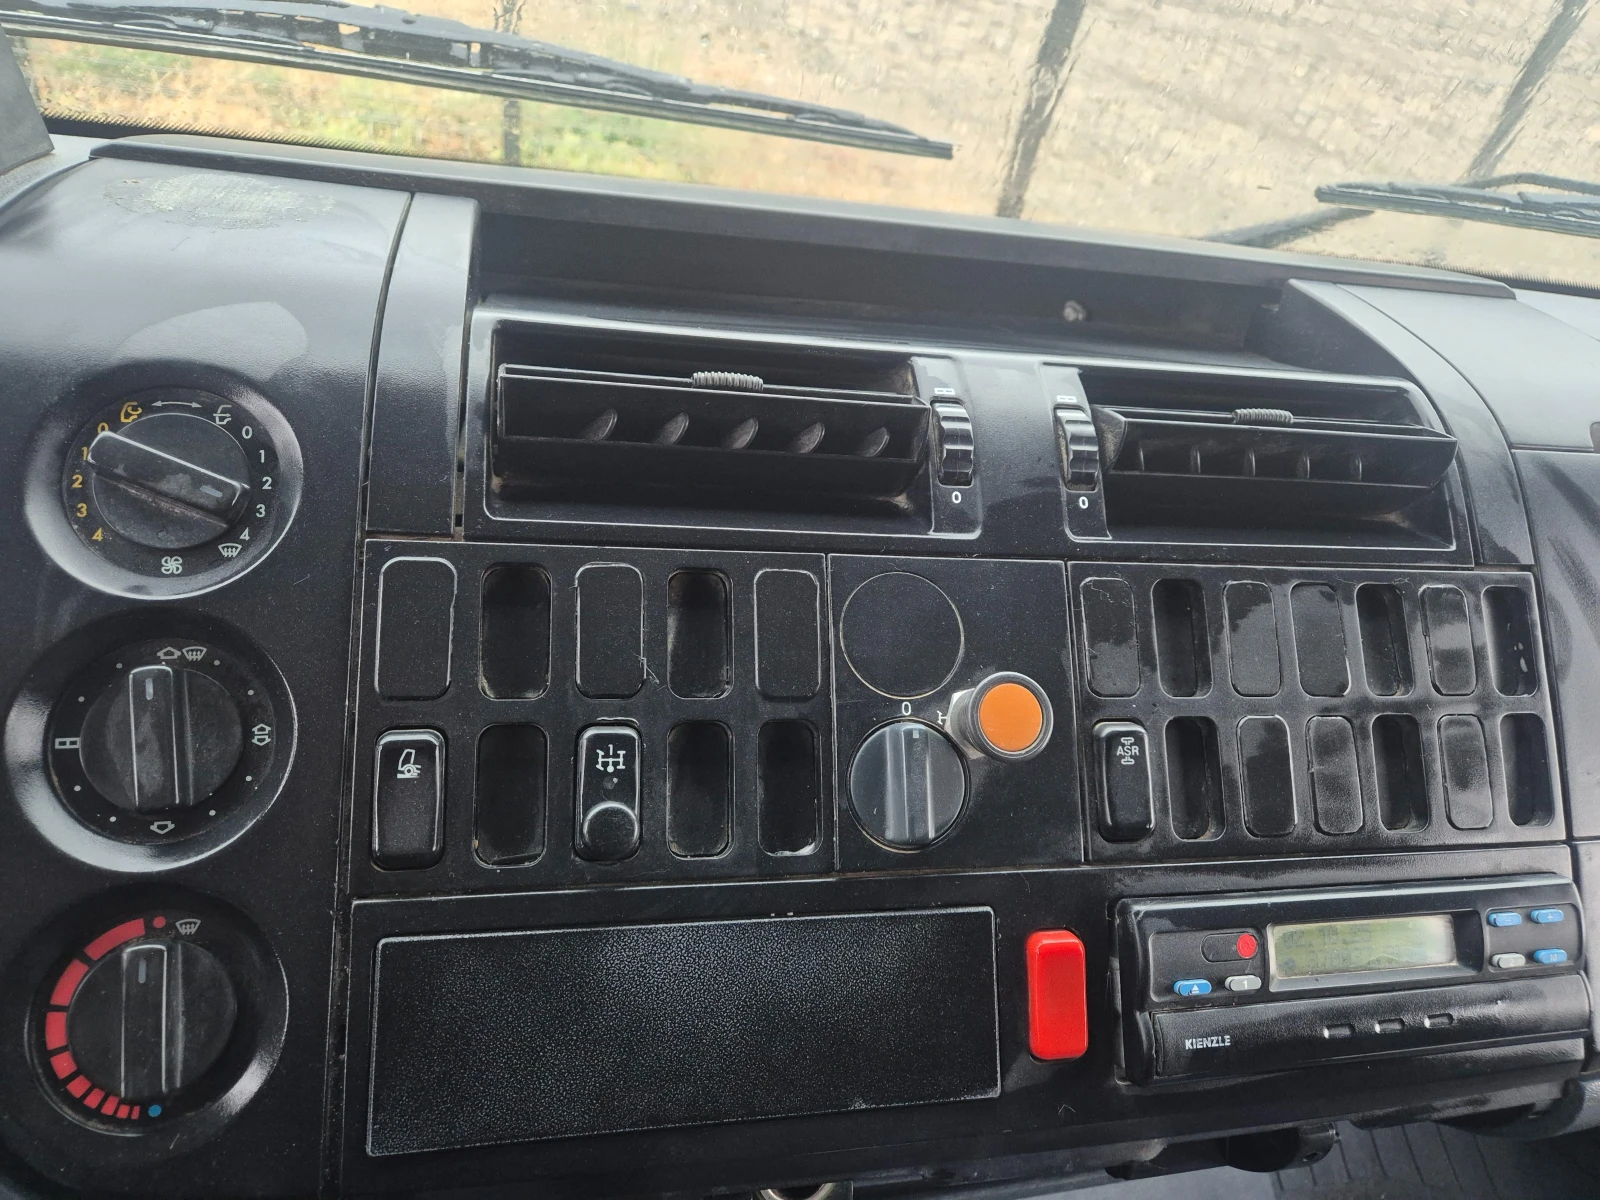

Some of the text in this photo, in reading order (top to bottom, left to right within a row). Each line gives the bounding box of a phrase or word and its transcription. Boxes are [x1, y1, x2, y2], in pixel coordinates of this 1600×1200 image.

[97, 422, 109, 434] 0
[241, 425, 253, 439] 0
[81, 446, 88, 461] 1
[258, 449, 265, 463] 1
[71, 474, 83, 488] 2
[262, 476, 272, 490] 2
[951, 490, 962, 504] 0
[1078, 496, 1089, 509] 0
[76, 503, 87, 517] 3
[255, 504, 266, 517] 3
[92, 527, 103, 541] 4
[239, 527, 250, 541] 4
[901, 701, 911, 716] 0
[1116, 745, 1140, 756] ASR
[1242, 979, 1248, 989] 1
[1184, 1034, 1232, 1051] KIENZLE
